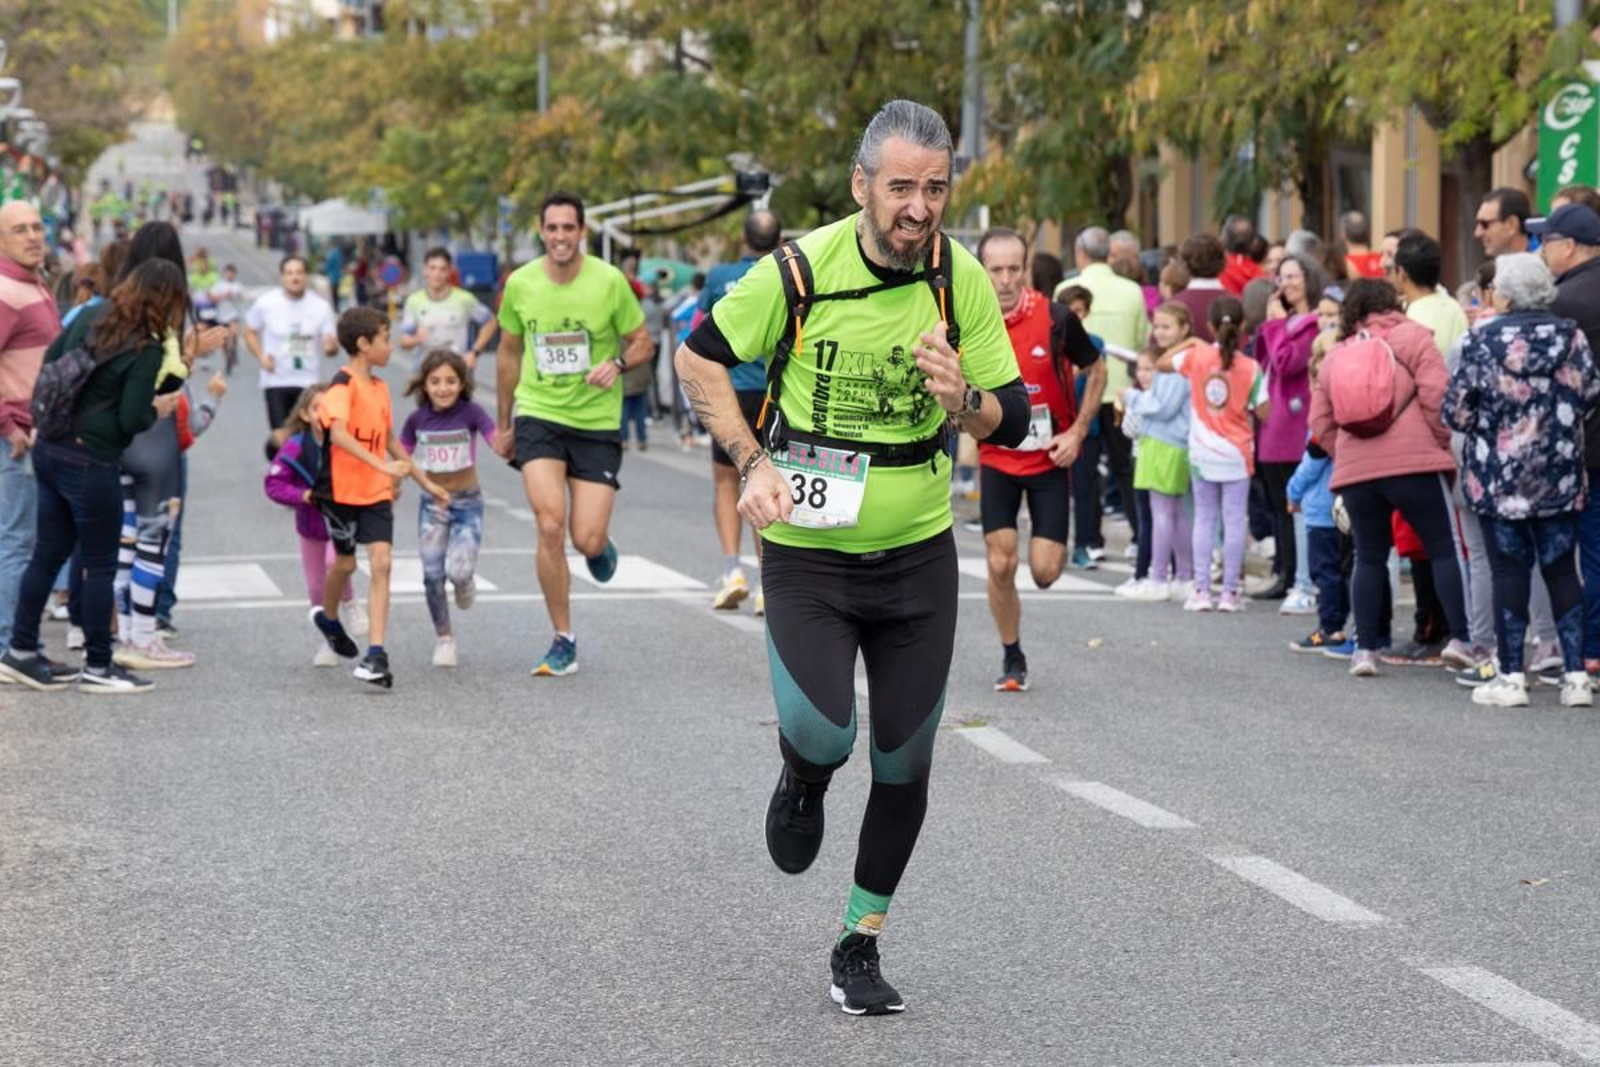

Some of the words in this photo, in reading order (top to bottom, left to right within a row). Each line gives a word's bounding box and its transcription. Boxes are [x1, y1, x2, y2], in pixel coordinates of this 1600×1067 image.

[545, 347, 578, 364] 385
[814, 339, 839, 372] 17
[427, 447, 459, 463] 507
[791, 473, 828, 509] 38
